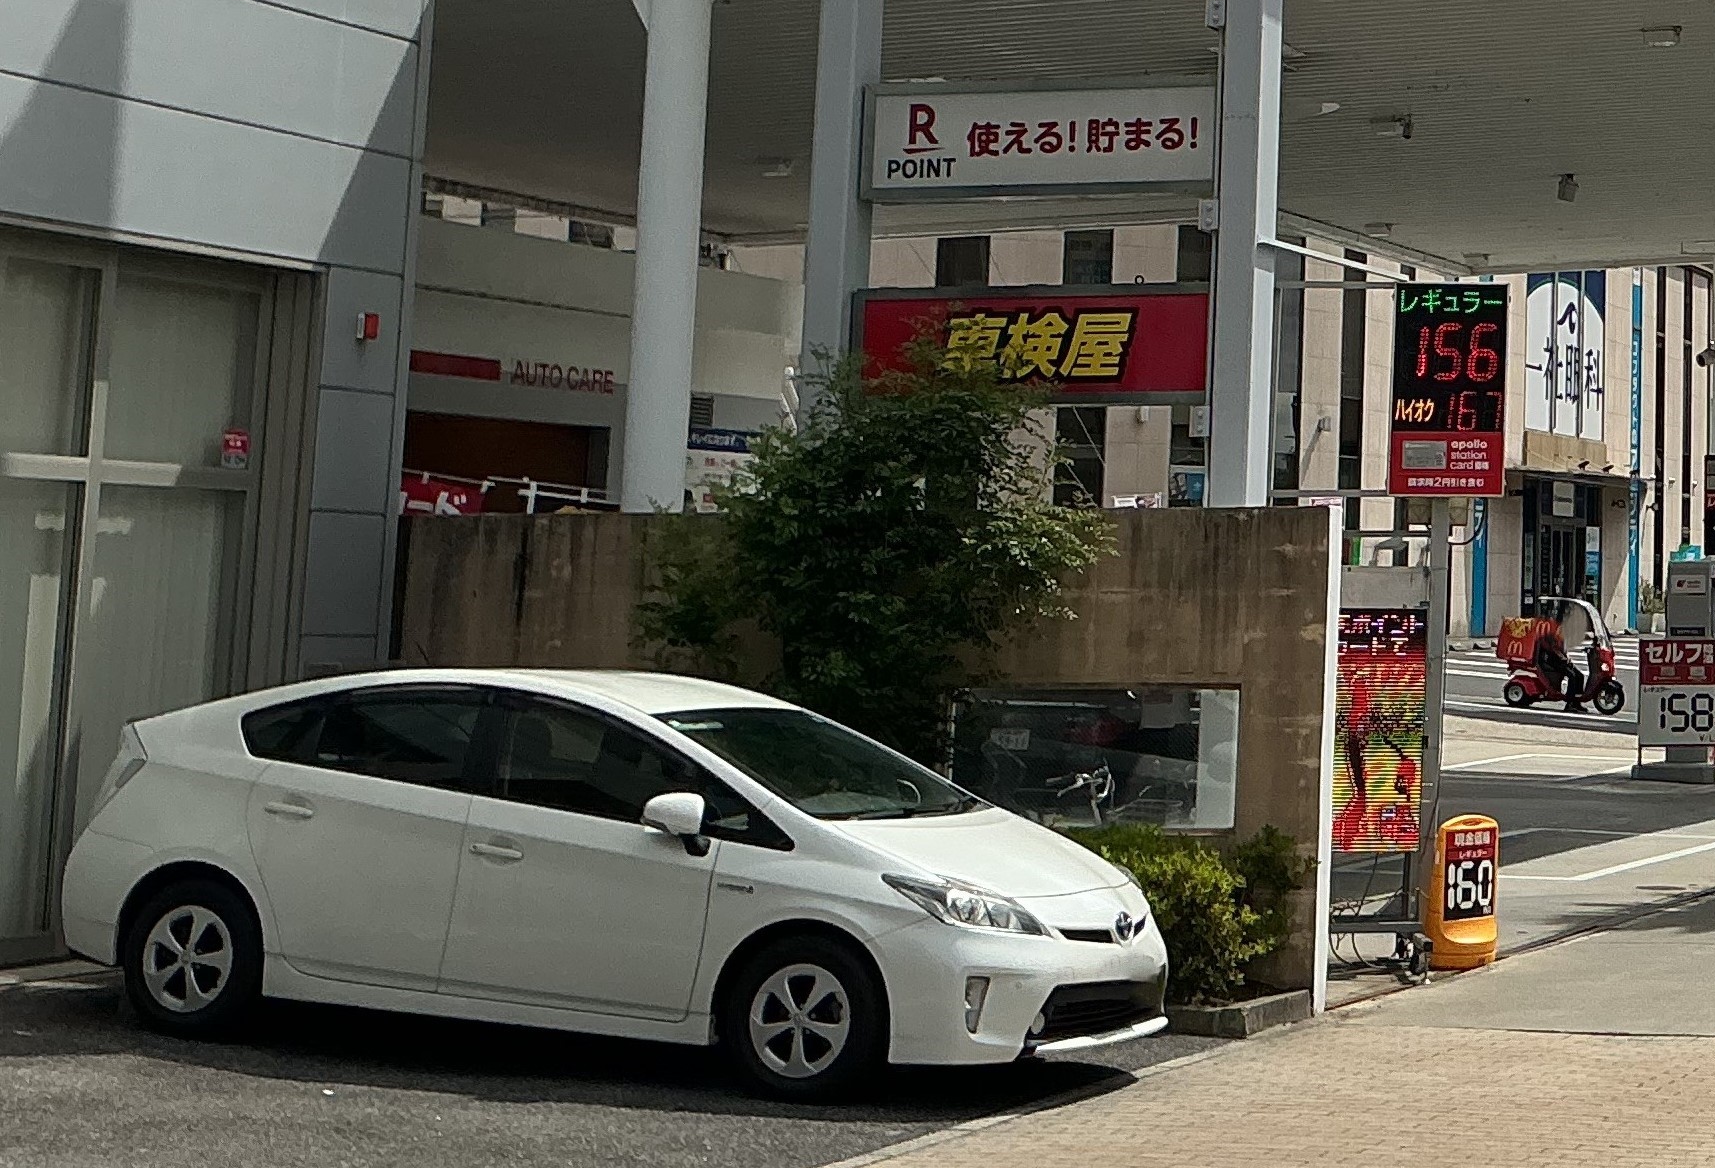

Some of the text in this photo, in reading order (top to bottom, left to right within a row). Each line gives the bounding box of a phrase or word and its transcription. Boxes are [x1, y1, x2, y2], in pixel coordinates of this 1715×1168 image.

[887, 158, 957, 179] POINT
[1400, 289, 1503, 314] レギュラー
[944, 312, 1133, 379] 車検屋
[1416, 322, 1498, 382] 156
[511, 359, 615, 395] AUTO CARE
[1394, 398, 1434, 422] ハイオク
[1450, 438, 1488, 451] apollo
[1450, 450, 1487, 460] station
[1450, 460, 1474, 470] card
[1645, 642, 1703, 664] セルフ
[1659, 693, 1714, 733] 158
[1447, 859, 1493, 910] 160
